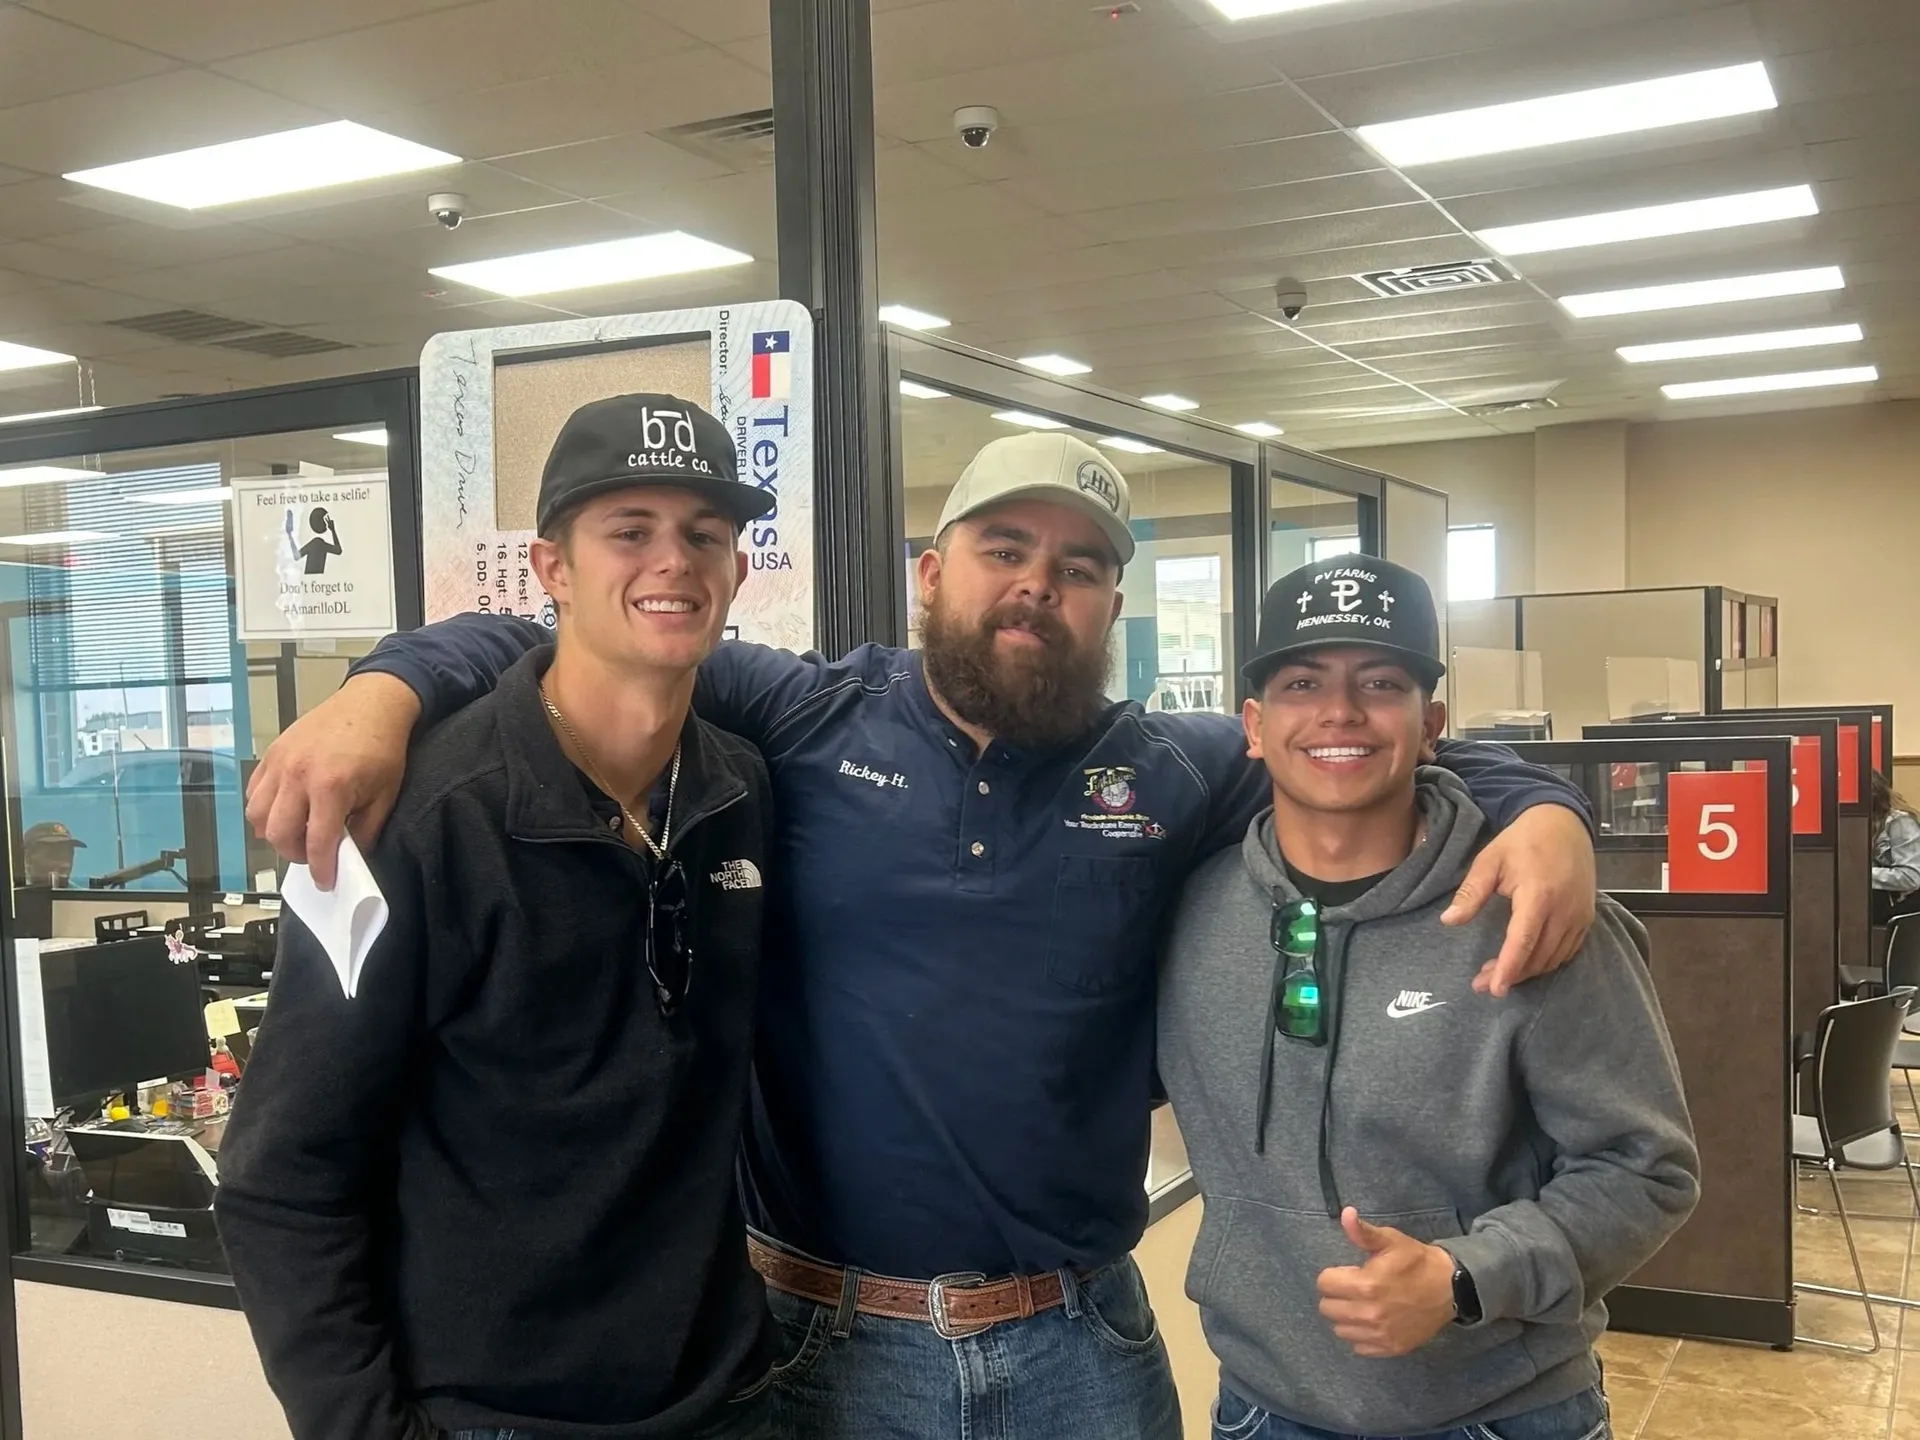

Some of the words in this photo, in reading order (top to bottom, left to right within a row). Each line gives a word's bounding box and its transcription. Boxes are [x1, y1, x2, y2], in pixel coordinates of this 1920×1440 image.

[719, 310, 730, 375] Director:
[736, 416, 747, 468] DRIVER
[627, 447, 685, 468] cattle
[691, 458, 713, 474] co.
[256, 493, 277, 506] Feel
[279, 492, 298, 505] free
[299, 493, 309, 504] to
[310, 490, 331, 503] take
[332, 493, 339, 501] a
[341, 488, 371, 501] selfie!
[497, 542, 508, 564] 16.
[518, 542, 529, 563] 12.
[752, 551, 793, 570] USA
[476, 560, 488, 587] DD:
[495, 568, 508, 598] Hgt:
[1314, 570, 1333, 584] PV
[1334, 568, 1378, 583] FARMS
[280, 581, 308, 594] Don't
[311, 581, 341, 596] forget
[343, 581, 354, 593] to
[518, 568, 529, 606] Rest:
[283, 600, 351, 615] #AmarilloDL
[1296, 613, 1371, 630] HENNESSEY,
[1374, 617, 1391, 629] OK
[838, 759, 891, 787] Rickey
[890, 772, 909, 789] H.
[1697, 803, 1738, 860] 5
[721, 860, 742, 870] THE
[709, 869, 745, 883] NORTH
[722, 879, 748, 891] FACE
[1396, 989, 1433, 1008] NIKE
